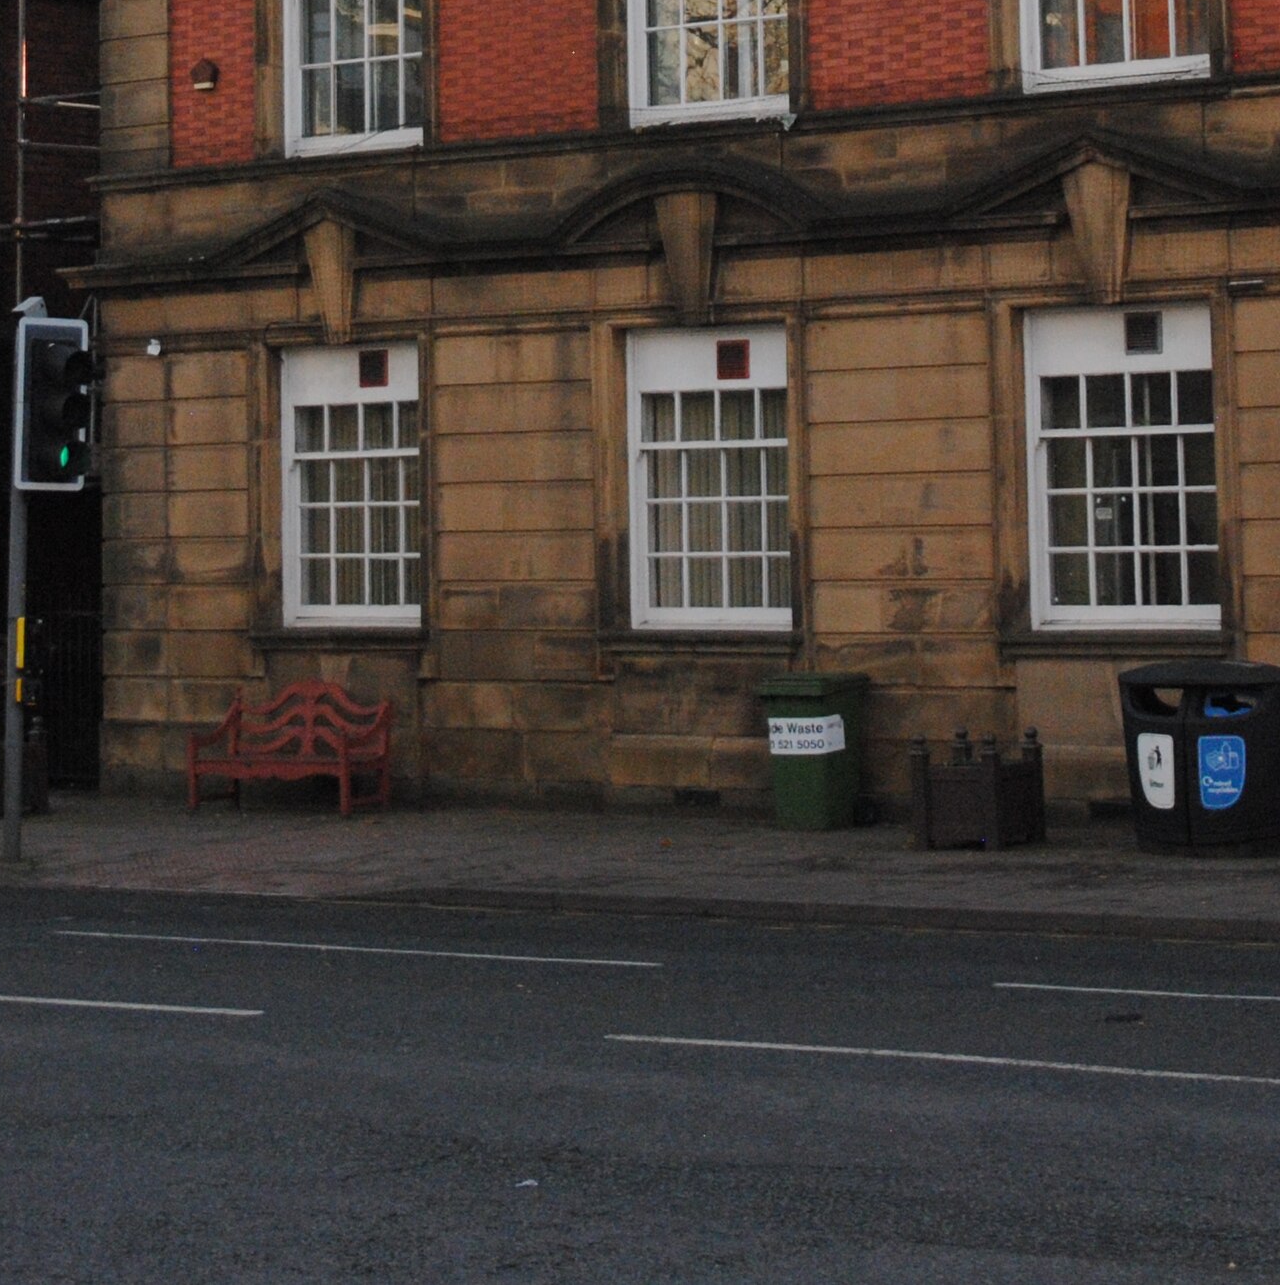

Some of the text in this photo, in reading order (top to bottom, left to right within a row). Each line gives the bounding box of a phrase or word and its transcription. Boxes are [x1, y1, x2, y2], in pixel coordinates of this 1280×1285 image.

[786, 722, 824, 734] Waste
[778, 739, 793, 749] 521
[796, 739, 825, 749] 5050
